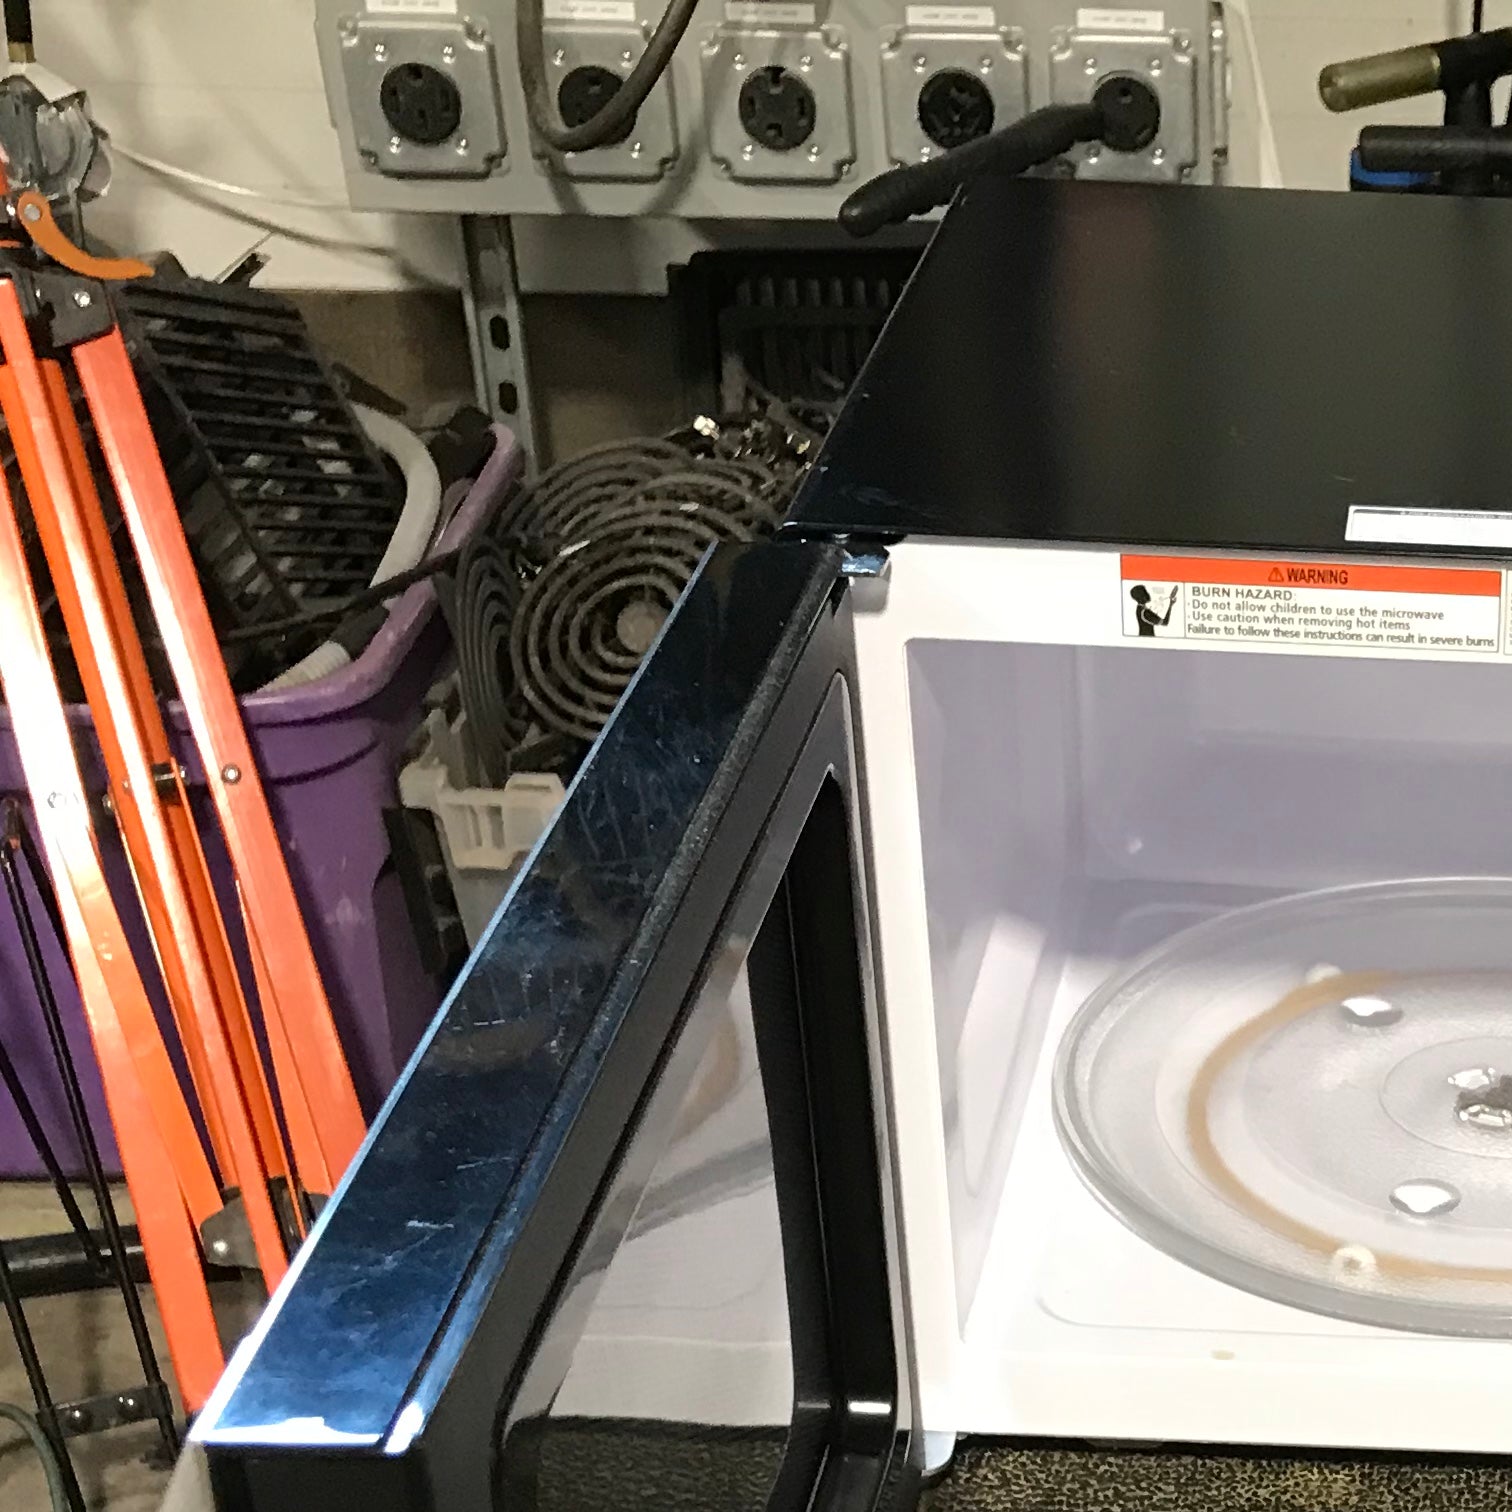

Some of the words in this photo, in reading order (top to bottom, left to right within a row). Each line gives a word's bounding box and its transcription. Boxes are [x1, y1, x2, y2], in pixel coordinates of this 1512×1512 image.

[1287, 568, 1349, 585] WARNING
[1192, 586, 1231, 599] BURN
[1192, 599, 1208, 610] Do
[1212, 601, 1231, 611] not
[1235, 601, 1267, 612] allow
[1270, 602, 1317, 615] children
[1321, 605, 1333, 615] to
[1336, 607, 1355, 617] use
[1359, 606, 1378, 618] the
[1381, 608, 1445, 621] microwave
[1192, 611, 1213, 621] Use
[1217, 612, 1260, 624] caution
[1264, 614, 1295, 625] when
[1298, 616, 1353, 630] removing
[1356, 618, 1375, 629] hot
[1379, 619, 1411, 631] items
[1187, 623, 1222, 635] Failure
[1224, 625, 1235, 635] to
[1237, 625, 1270, 637] follow
[1273, 627, 1301, 638] these
[1304, 628, 1362, 641] instructions
[1366, 632, 1383, 642] can
[1386, 632, 1415, 644] result
[1417, 633, 1427, 644] in
[1430, 635, 1463, 646] severe
[1466, 635, 1495, 647] burns
